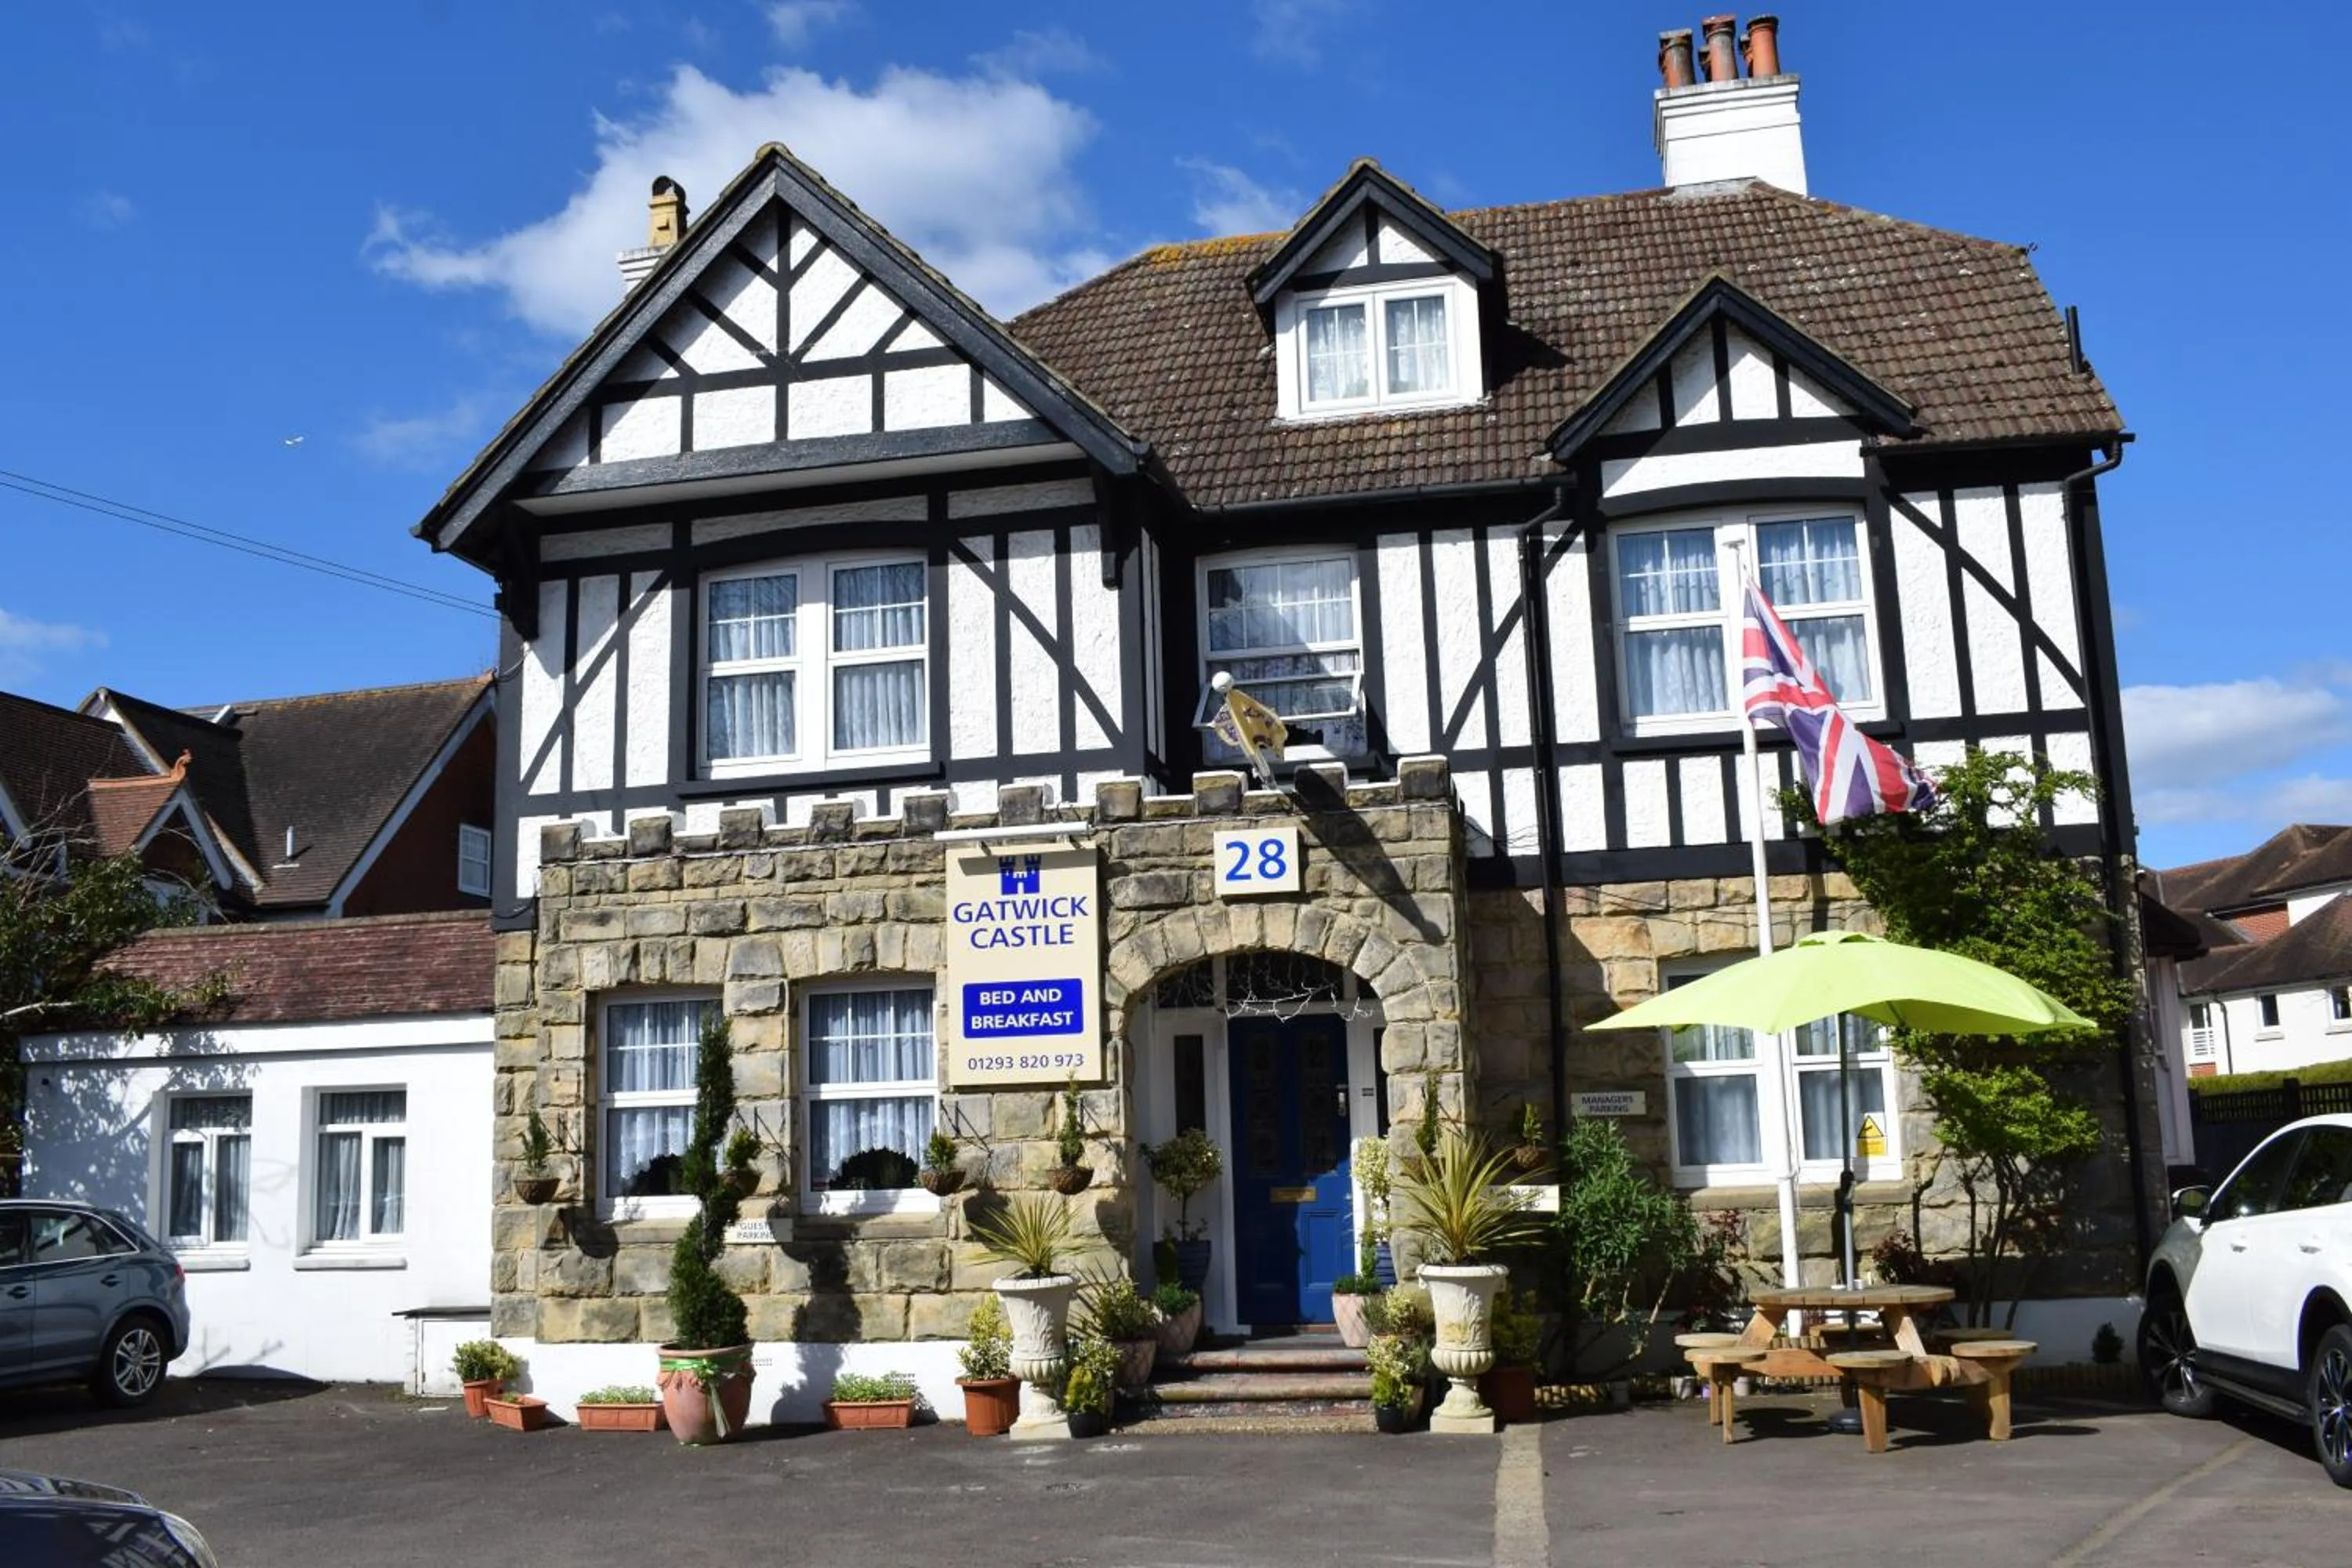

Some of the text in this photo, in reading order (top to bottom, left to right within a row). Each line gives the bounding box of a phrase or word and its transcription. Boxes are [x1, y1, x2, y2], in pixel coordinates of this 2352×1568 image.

[1225, 838, 1287, 881] 28
[953, 896, 1089, 924] GATWICK
[970, 924, 1076, 949] CASTLE
[979, 989, 1062, 1006] BED AND
[971, 1011, 1074, 1030] BREAKFAST
[967, 1053, 1084, 1071] 01293 820 973
